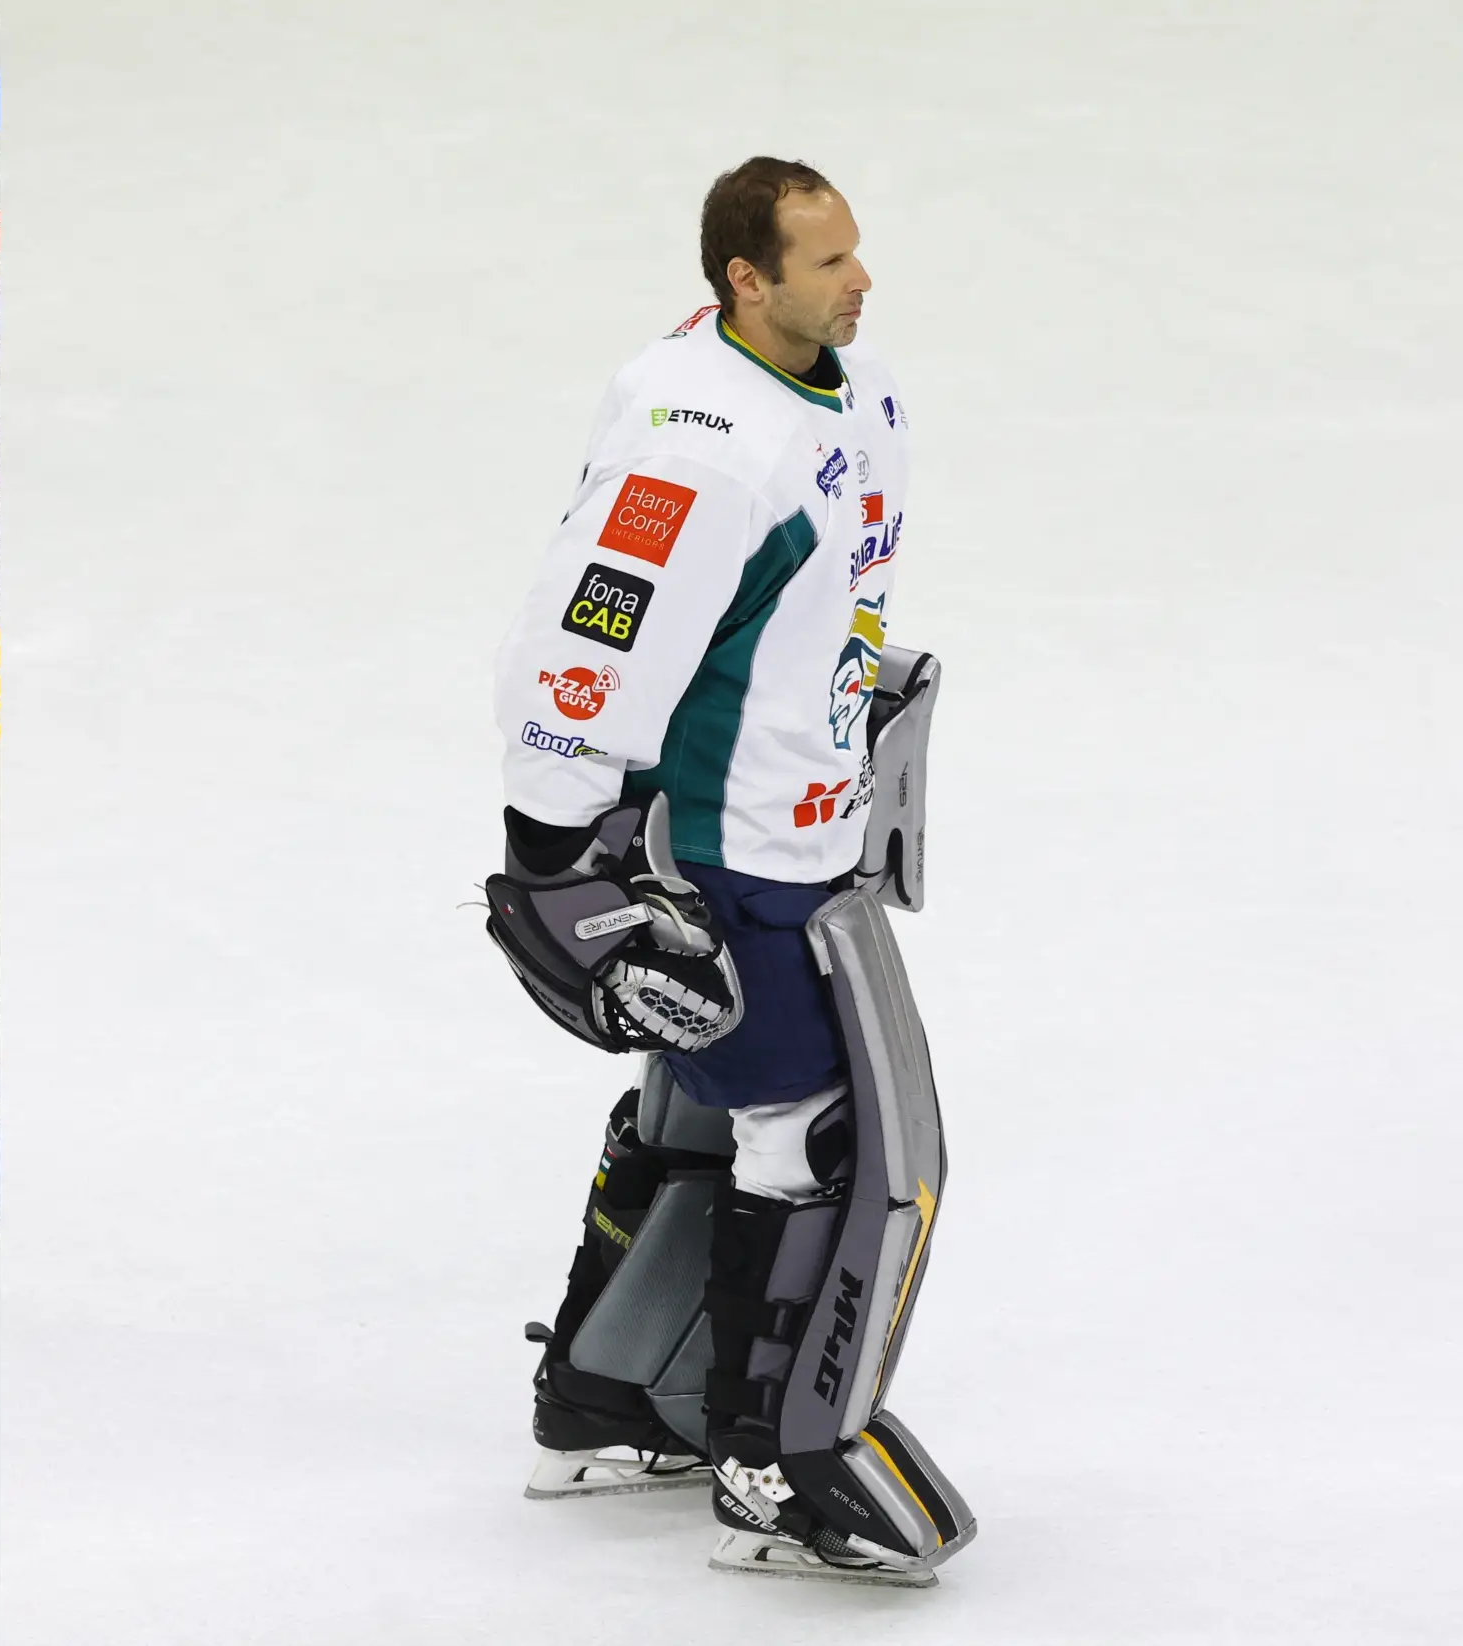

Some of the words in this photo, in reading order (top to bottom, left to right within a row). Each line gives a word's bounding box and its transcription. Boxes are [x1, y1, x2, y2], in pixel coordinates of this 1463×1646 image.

[668, 408, 734, 434] ETRUX
[626, 485, 684, 520] Harry
[611, 528, 665, 550] INTERIORS
[618, 505, 675, 541] Corry
[584, 574, 640, 615] fona
[571, 600, 633, 640] CAB
[538, 670, 592, 700] PIZZA
[559, 692, 598, 712] GUYZ
[583, 912, 637, 934] VENTURE
[719, 1494, 791, 1539] BAUE
[829, 1486, 849, 1505] PETR
[848, 1500, 871, 1519] ČECH
